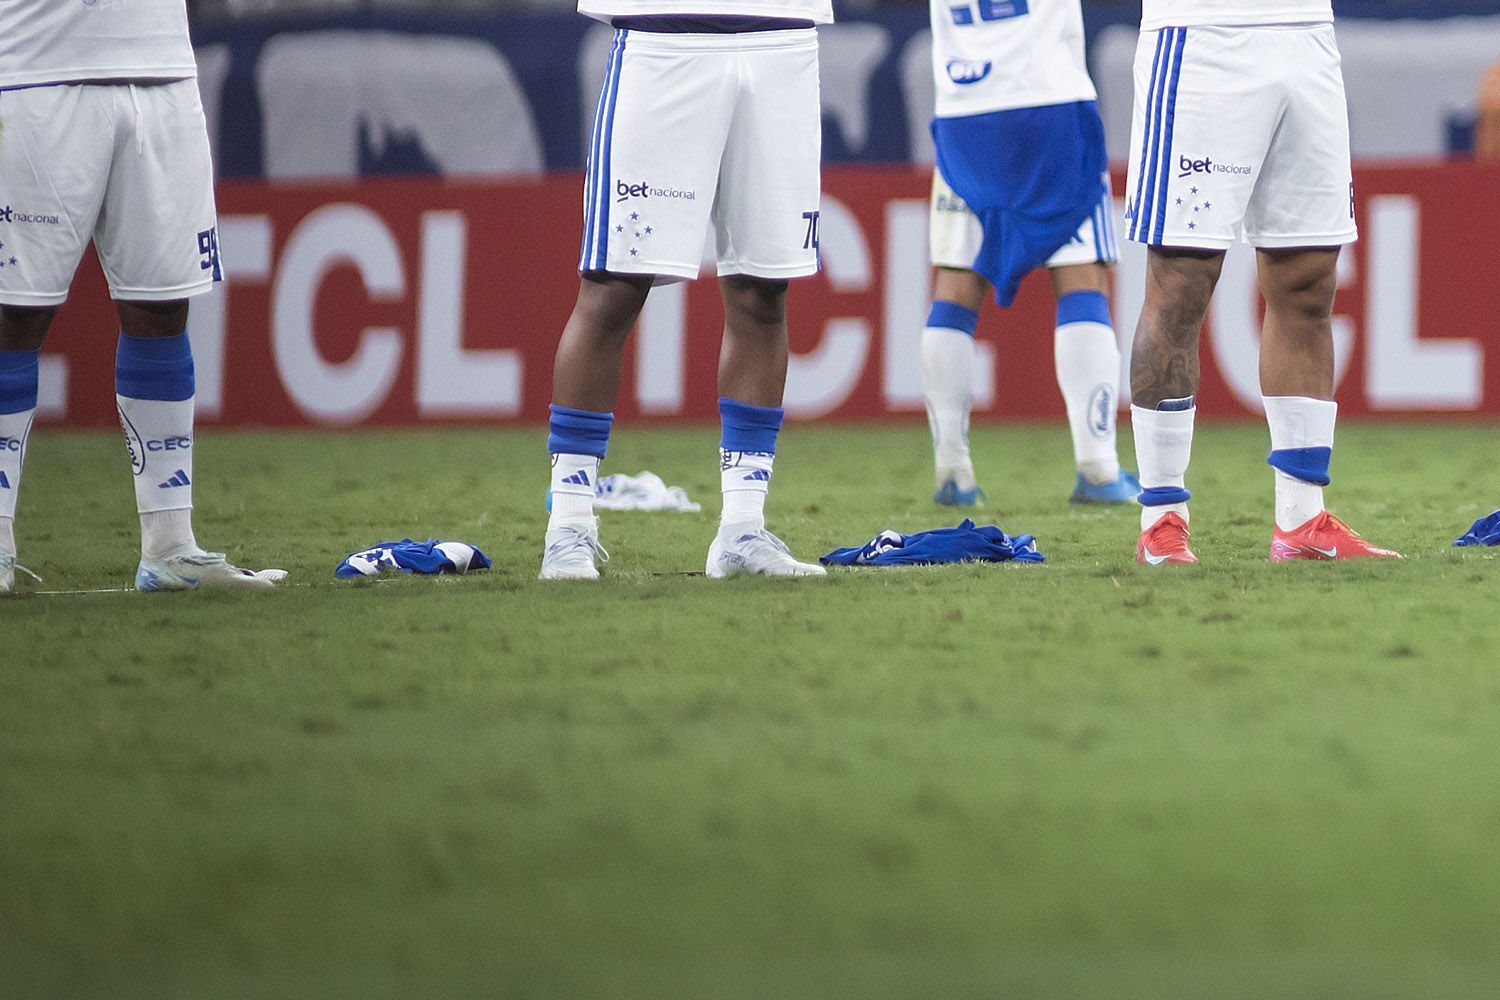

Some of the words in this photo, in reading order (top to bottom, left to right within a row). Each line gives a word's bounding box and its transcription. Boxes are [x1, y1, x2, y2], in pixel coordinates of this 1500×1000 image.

[1180, 155, 1212, 173] bet
[617, 179, 648, 198] bet
[650, 186, 696, 200] nacional
[0, 205, 12, 223] et
[13, 211, 59, 225] nacional
[146, 436, 190, 451] CEC
